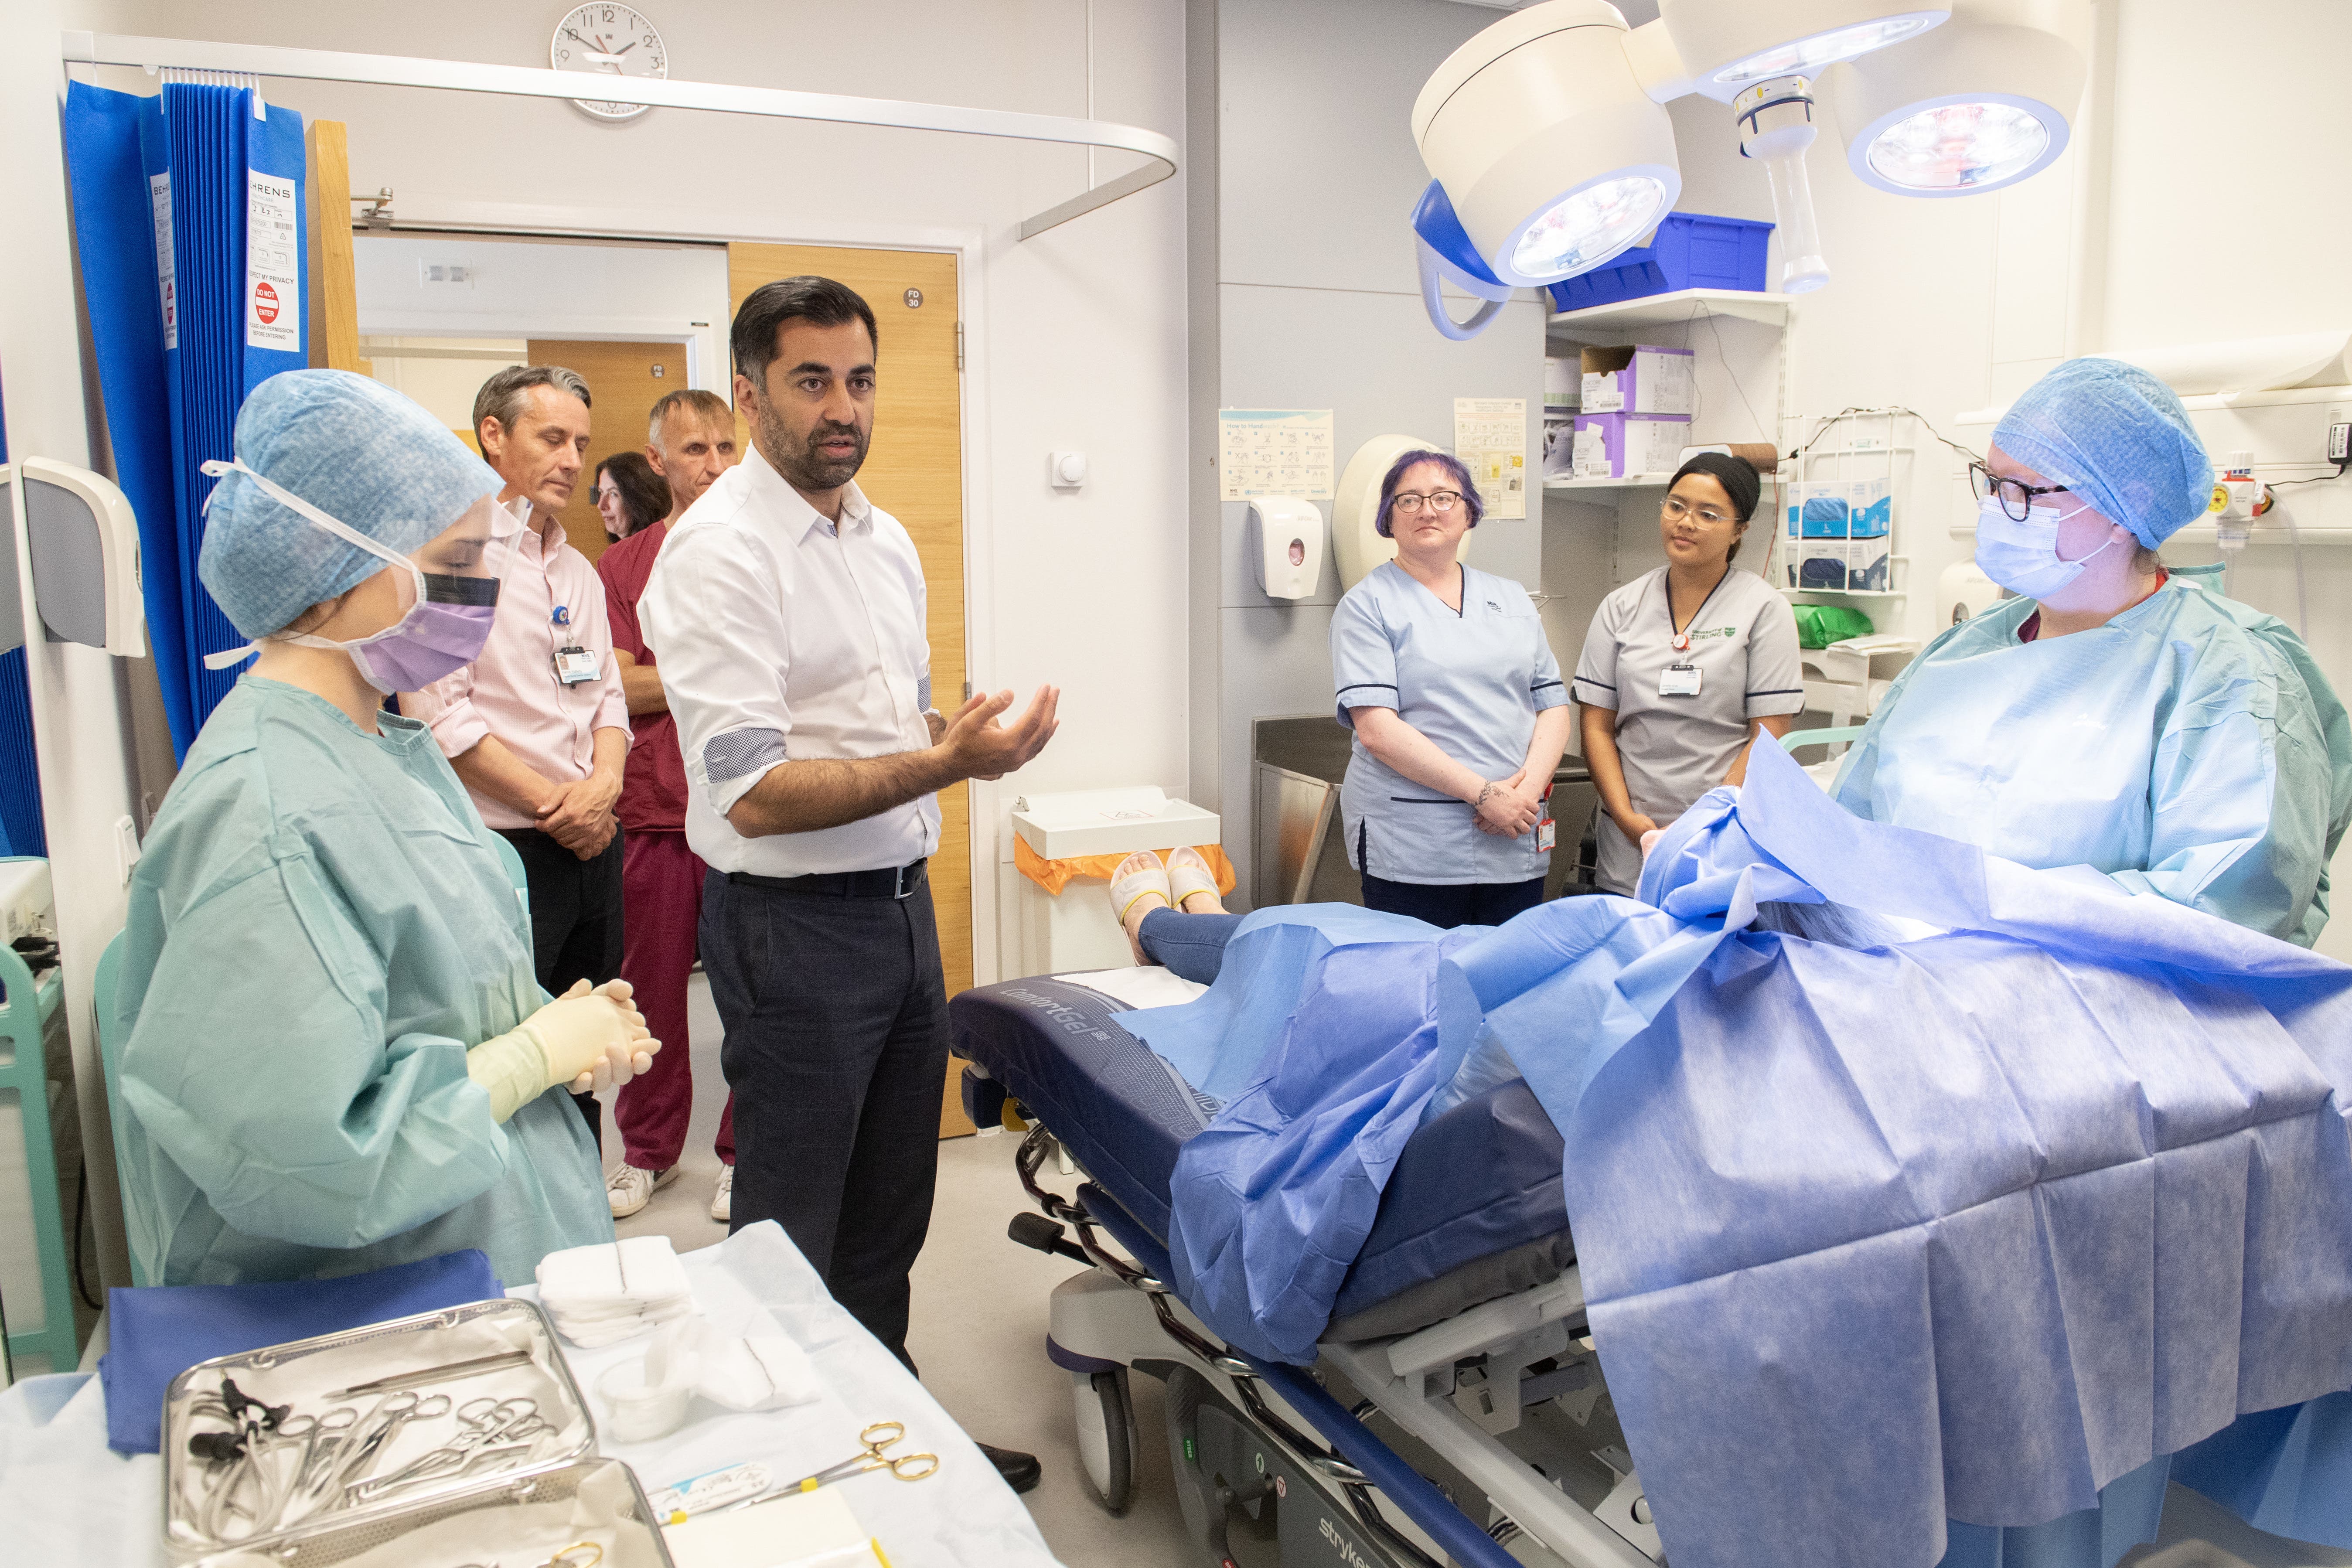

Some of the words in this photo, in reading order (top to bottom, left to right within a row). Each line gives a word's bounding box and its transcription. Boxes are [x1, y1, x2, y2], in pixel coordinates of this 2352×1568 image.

[583, 14, 593, 27] 11
[602, 10, 614, 22] 12
[567, 27, 578, 41] 10
[643, 34, 653, 48] 2
[560, 49, 570, 62] 9
[650, 56, 659, 69] 3
[269, 275, 294, 285] PRIVACY
[264, 290, 275, 298] NOT
[908, 290, 919, 298] FD
[259, 308, 275, 317] ENTER
[267, 326, 294, 334] PERMISSION
[1691, 632, 1721, 640] STIRLING
[999, 989, 1100, 1035] ComfortGel
